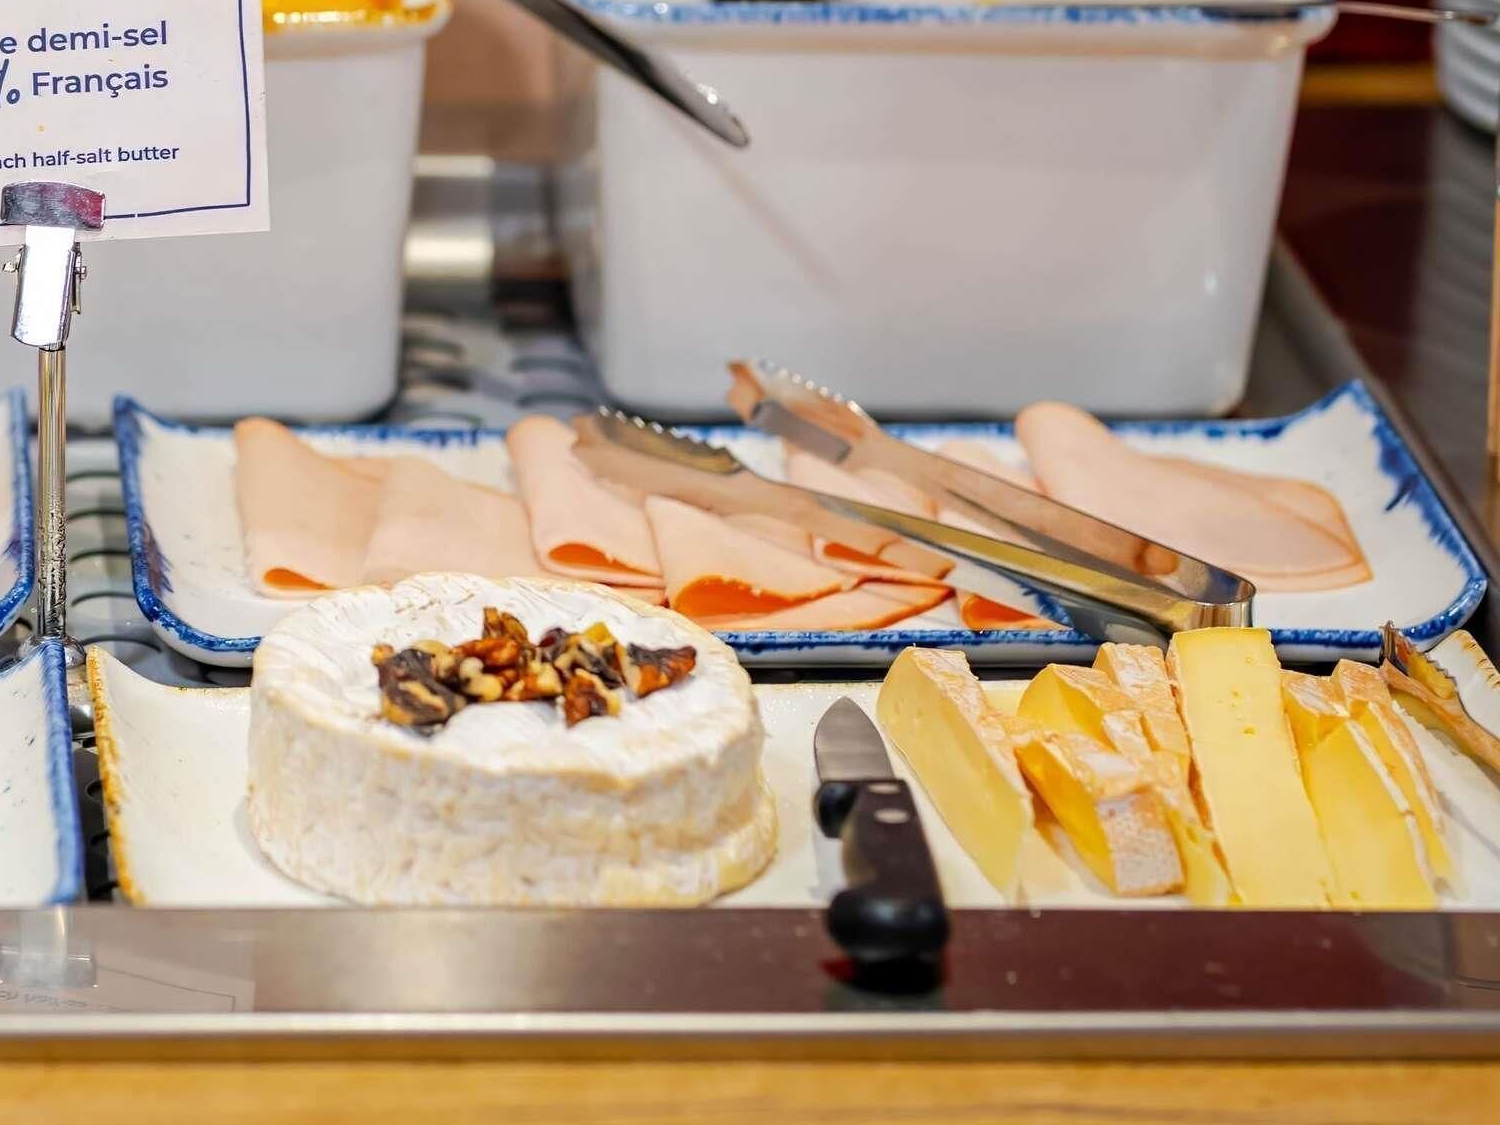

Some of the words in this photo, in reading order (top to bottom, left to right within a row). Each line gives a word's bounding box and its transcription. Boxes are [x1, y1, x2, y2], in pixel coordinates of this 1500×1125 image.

[27, 19, 167, 53] demi-sel
[32, 63, 169, 99] Français
[32, 147, 112, 168] half-salt
[117, 146, 180, 163] butter
